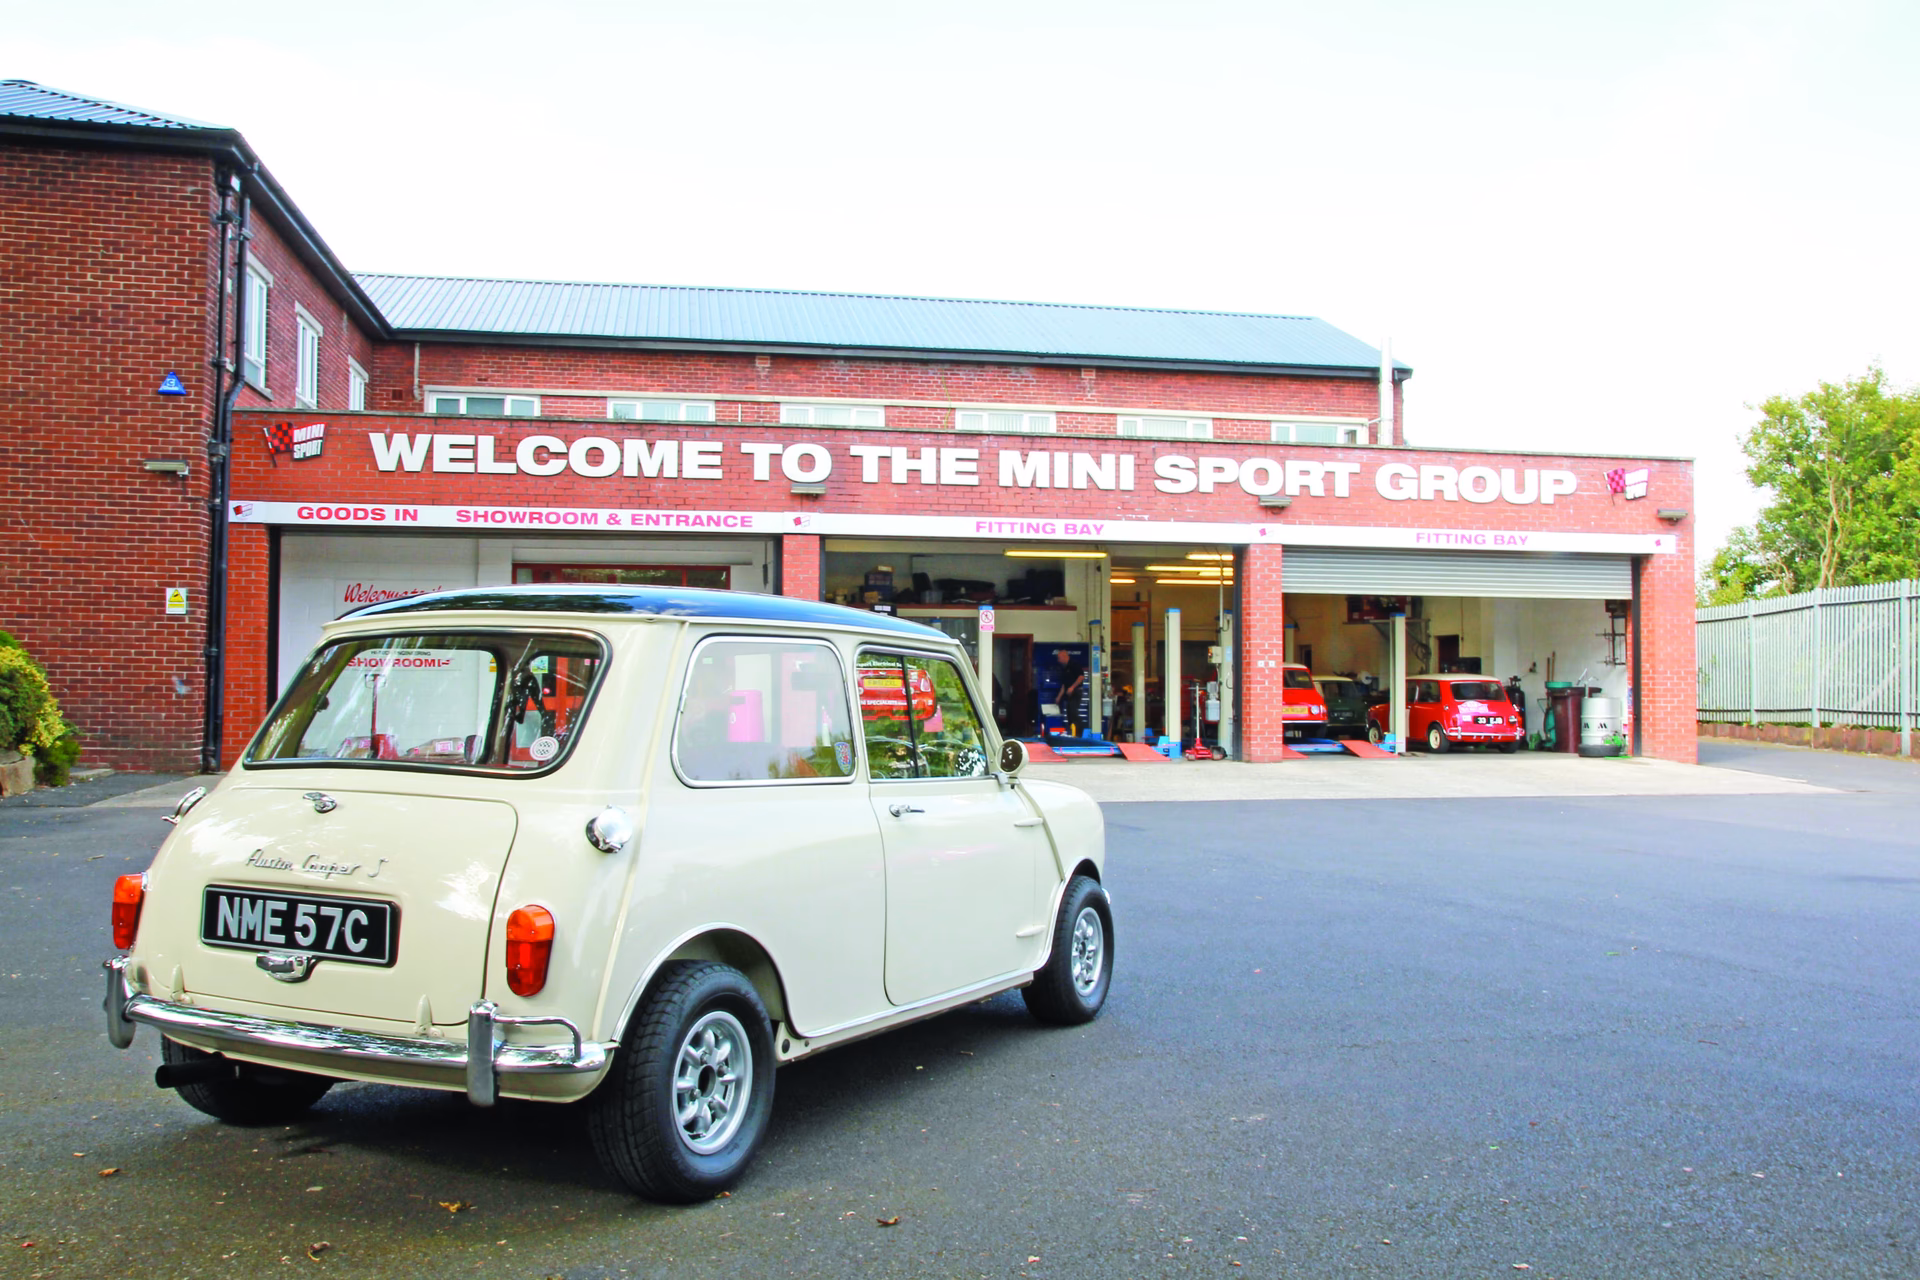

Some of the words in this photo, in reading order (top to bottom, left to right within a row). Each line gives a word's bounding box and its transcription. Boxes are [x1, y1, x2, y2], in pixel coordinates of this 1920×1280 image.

[293, 423, 325, 443] MINI
[293, 439, 322, 459] SPORT
[369, 432, 723, 479] WELCOME
[740, 442, 833, 484] TO
[849, 445, 979, 486] THE
[998, 449, 1135, 491] MINI
[1153, 454, 1361, 498] SPORT
[1374, 462, 1578, 505] GROUP
[297, 506, 387, 522] GOODS
[394, 508, 419, 522] IN
[455, 509, 599, 525] SHOWROOM
[605, 512, 622, 526] &
[630, 513, 754, 529] ENTRANCE
[975, 521, 1057, 535] FITTING
[1063, 523, 1106, 536] BAY
[1415, 532, 1487, 545] FITTING
[1493, 534, 1530, 546] BAY
[246, 848, 294, 872] Austin
[302, 854, 361, 880] Cooper
[367, 857, 389, 878] S
[216, 895, 289, 945] NME
[293, 903, 369, 954] 57C
